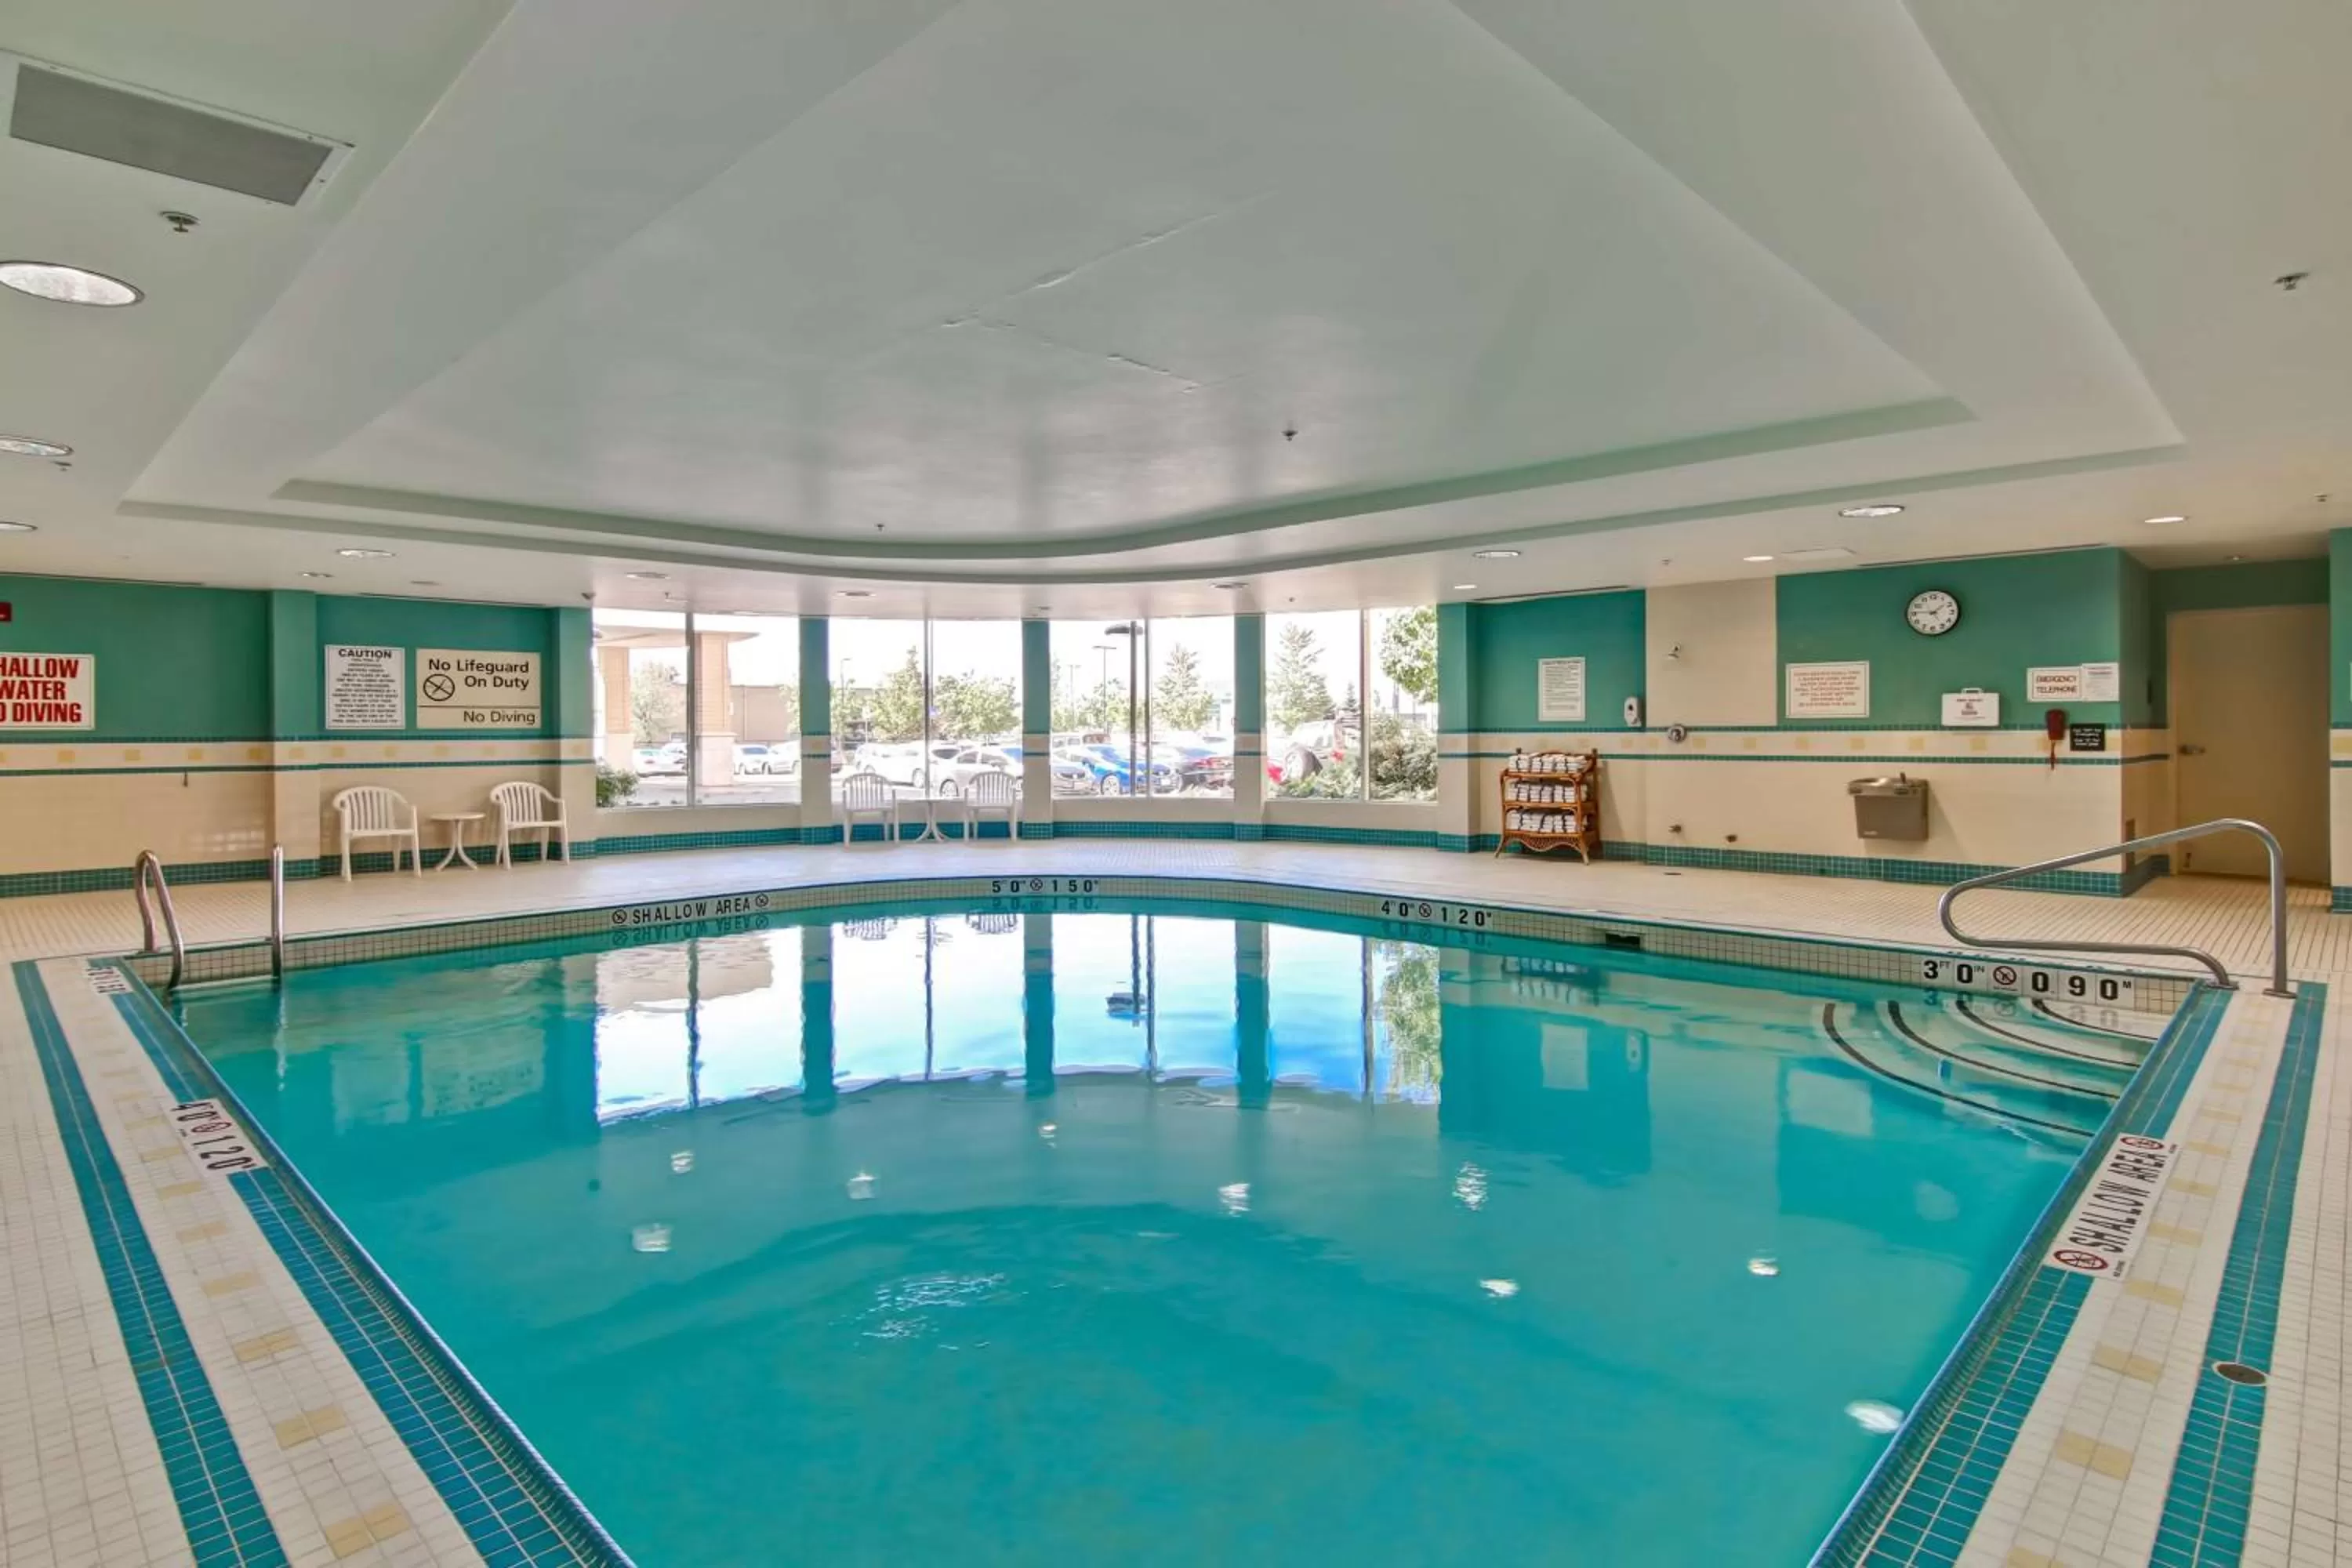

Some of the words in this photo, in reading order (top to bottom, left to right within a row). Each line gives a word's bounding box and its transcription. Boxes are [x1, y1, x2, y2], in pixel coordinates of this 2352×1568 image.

[338, 648, 392, 659] CAUTION
[428, 659, 451, 671] No
[456, 659, 530, 675] Lifeguard
[0, 680, 66, 700] WATER
[464, 675, 488, 688] On
[493, 676, 530, 691] Duty
[13, 702, 82, 723] DIVING
[463, 710, 485, 724] No
[490, 711, 535, 726] Diving
[633, 902, 706, 924] SHALLOW
[715, 897, 750, 915] AREA
[2107, 1149, 2169, 1183] AREA
[2068, 1180, 2151, 1253] SHALLOW
